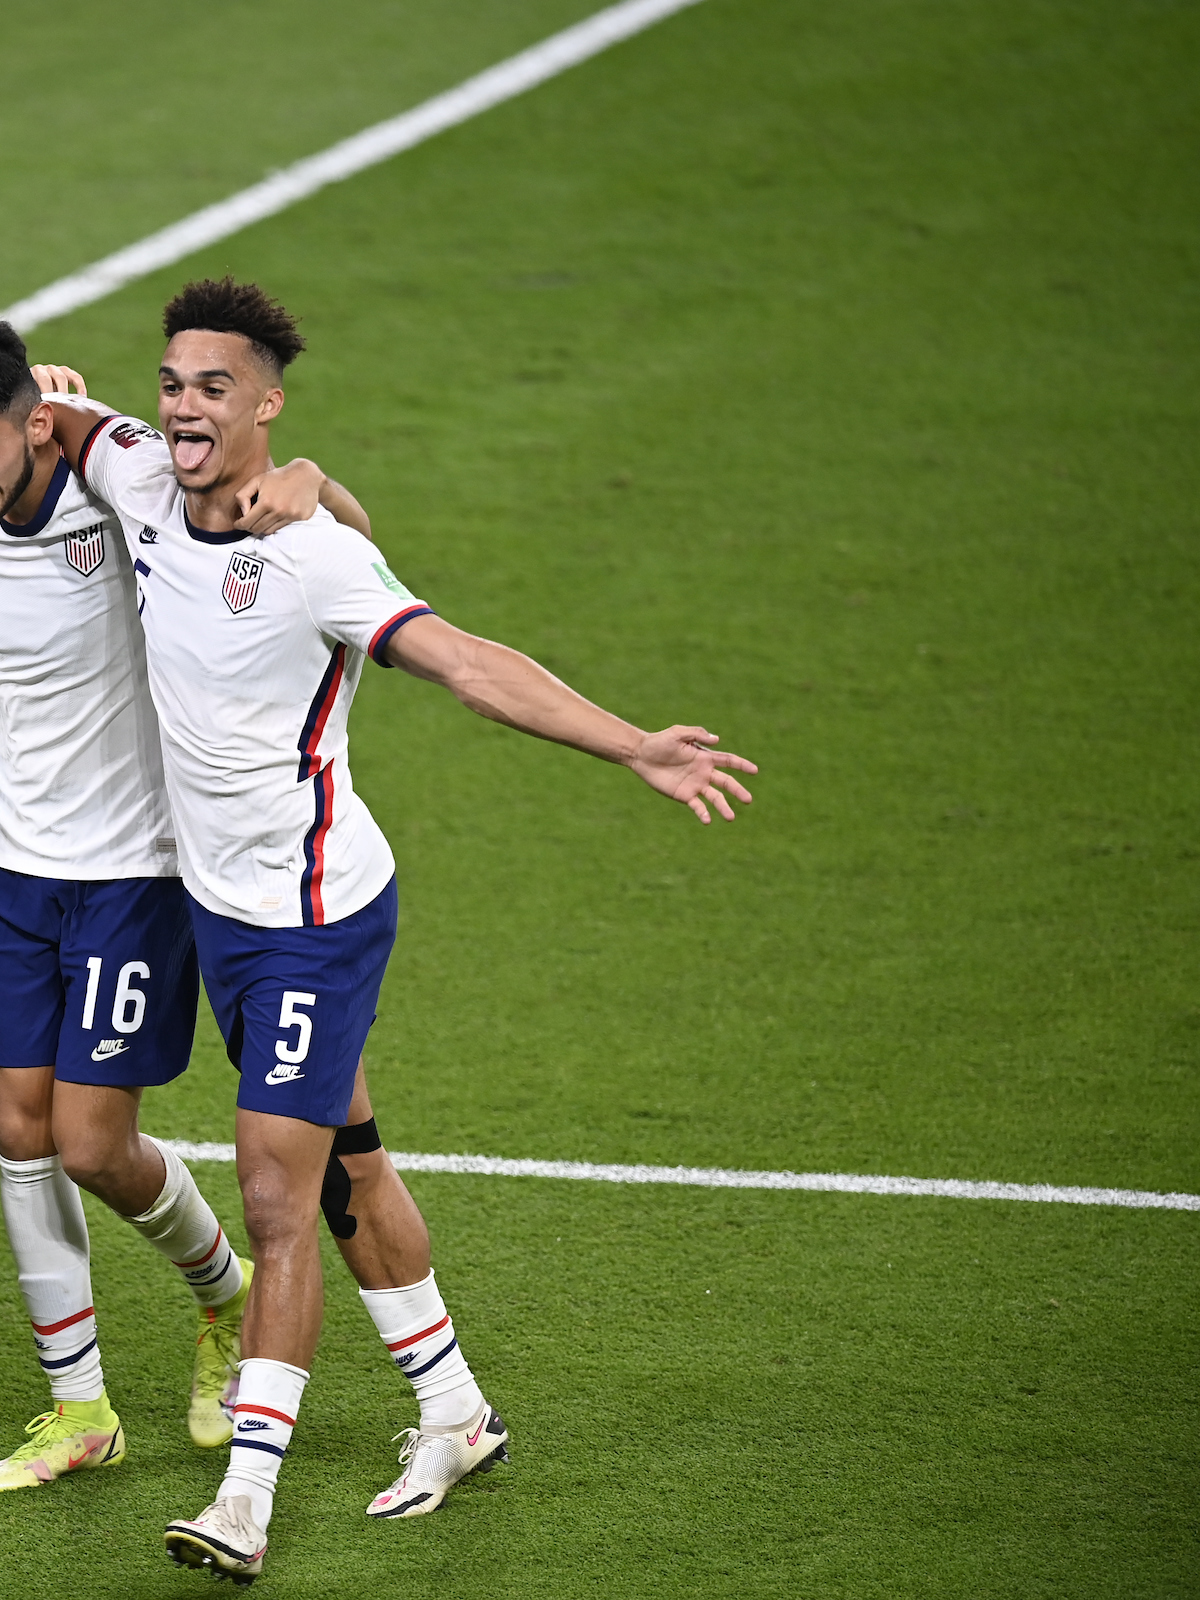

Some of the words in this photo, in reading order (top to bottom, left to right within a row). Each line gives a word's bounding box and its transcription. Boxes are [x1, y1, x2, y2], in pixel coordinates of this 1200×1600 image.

[143, 526, 159, 541] NIKE
[232, 557, 259, 580] USA
[81, 956, 151, 1034] 16
[275, 991, 317, 1064] 5
[97, 1039, 125, 1053] NIKE
[272, 1063, 301, 1078] NIKE
[395, 1351, 415, 1365] NIKE
[242, 1419, 269, 1429] NIKE
